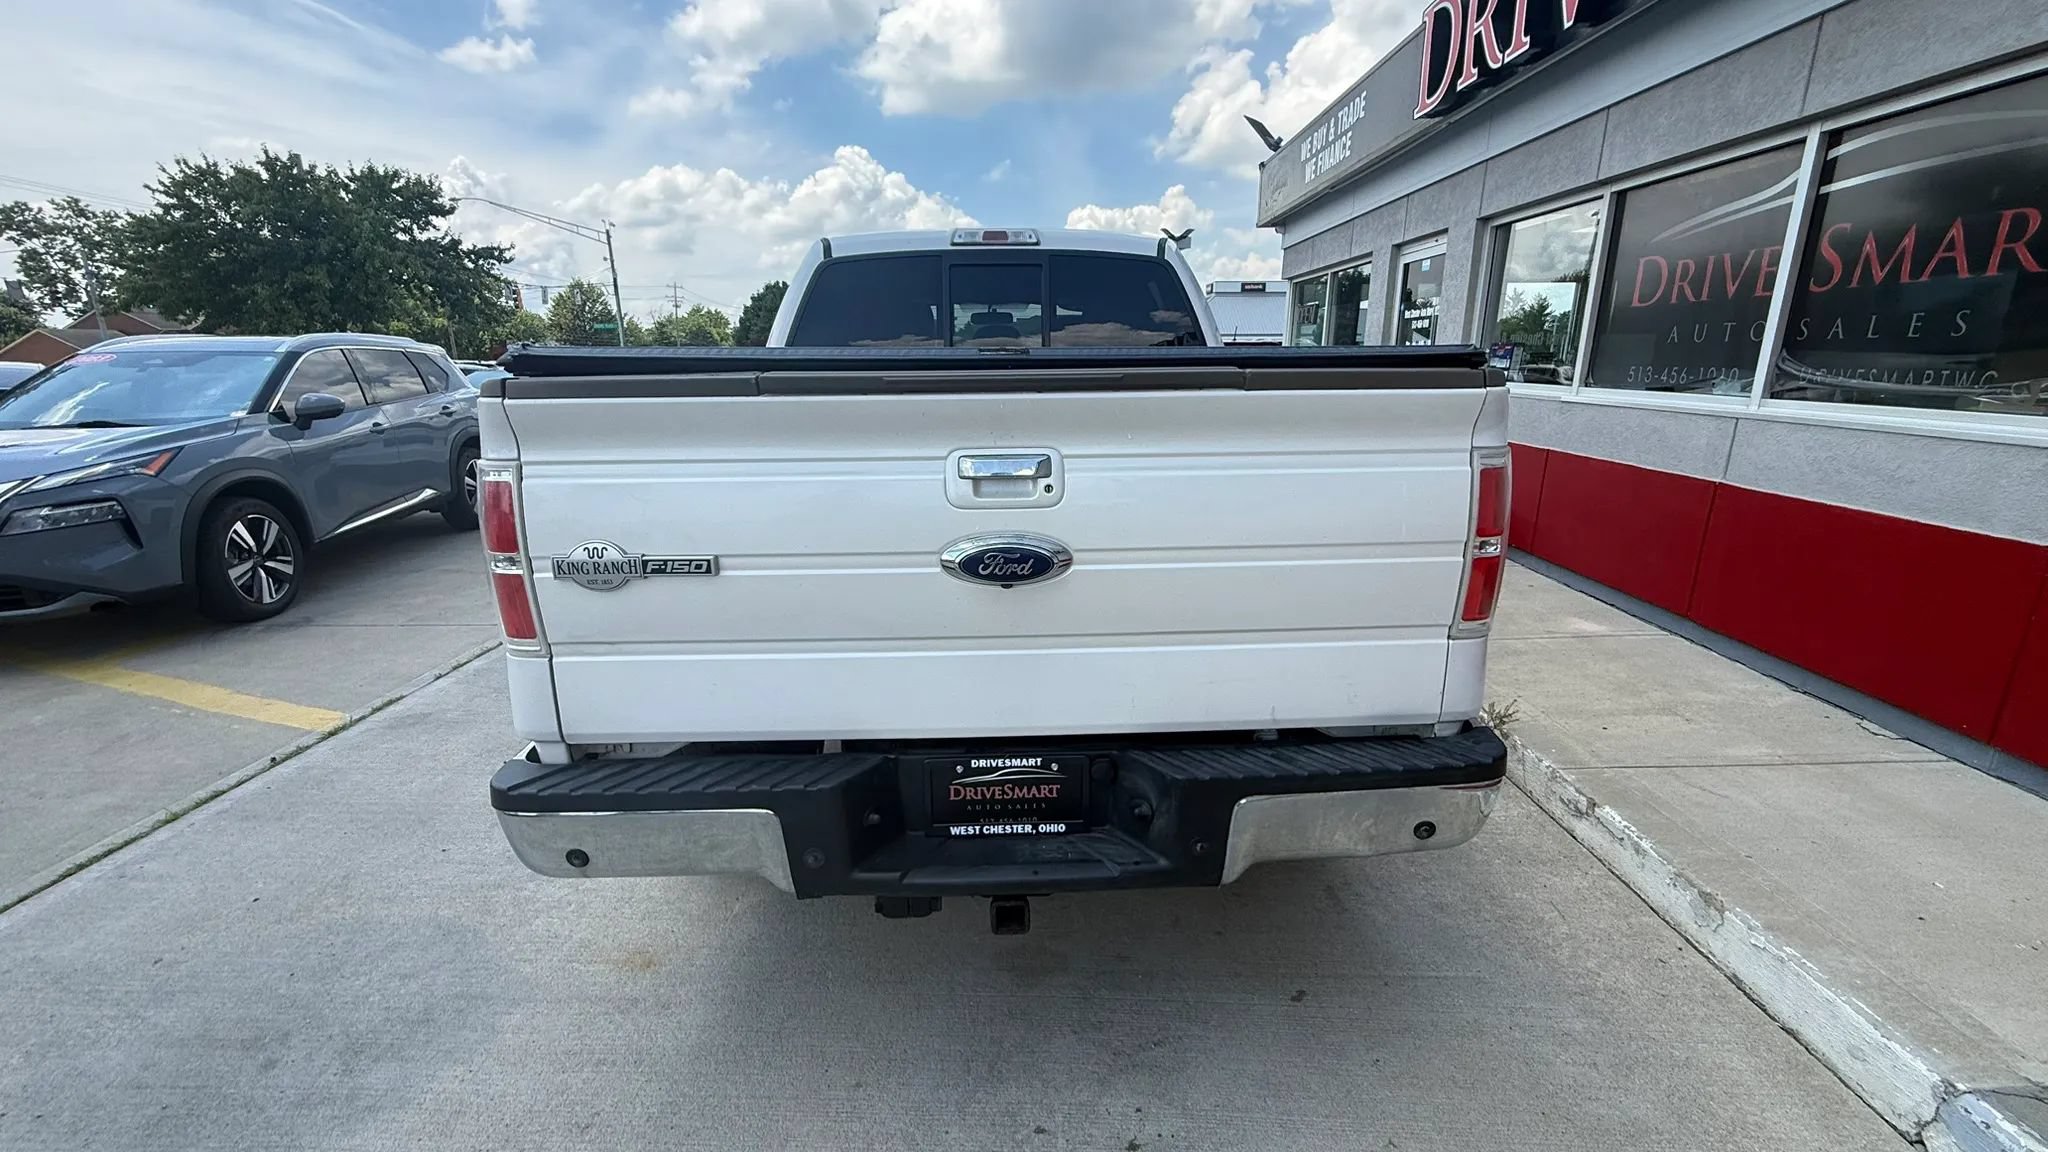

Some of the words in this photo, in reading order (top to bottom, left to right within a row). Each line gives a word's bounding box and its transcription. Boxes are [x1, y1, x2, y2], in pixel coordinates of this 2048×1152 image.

[1301, 136, 1311, 161] WE
[1312, 122, 1328, 154] BUY
[1328, 117, 1335, 142] &
[1337, 90, 1366, 135] TRADE
[1305, 157, 1316, 183] WE
[1317, 131, 1352, 176] FINANCE
[1667, 321, 1766, 343] AUTO
[1797, 310, 1971, 341] SALES
[556, 559, 590, 576] KING
[593, 559, 638, 575] RANCH
[646, 560, 708, 573] F-150
[978, 552, 1034, 575] Ford
[971, 757, 1042, 768] DRIVESMART
[949, 783, 1061, 801] DRIVESMART
[950, 825, 980, 836] WEST
[982, 824, 1036, 835] CHESTER,
[1038, 823, 1066, 833] OHIO
